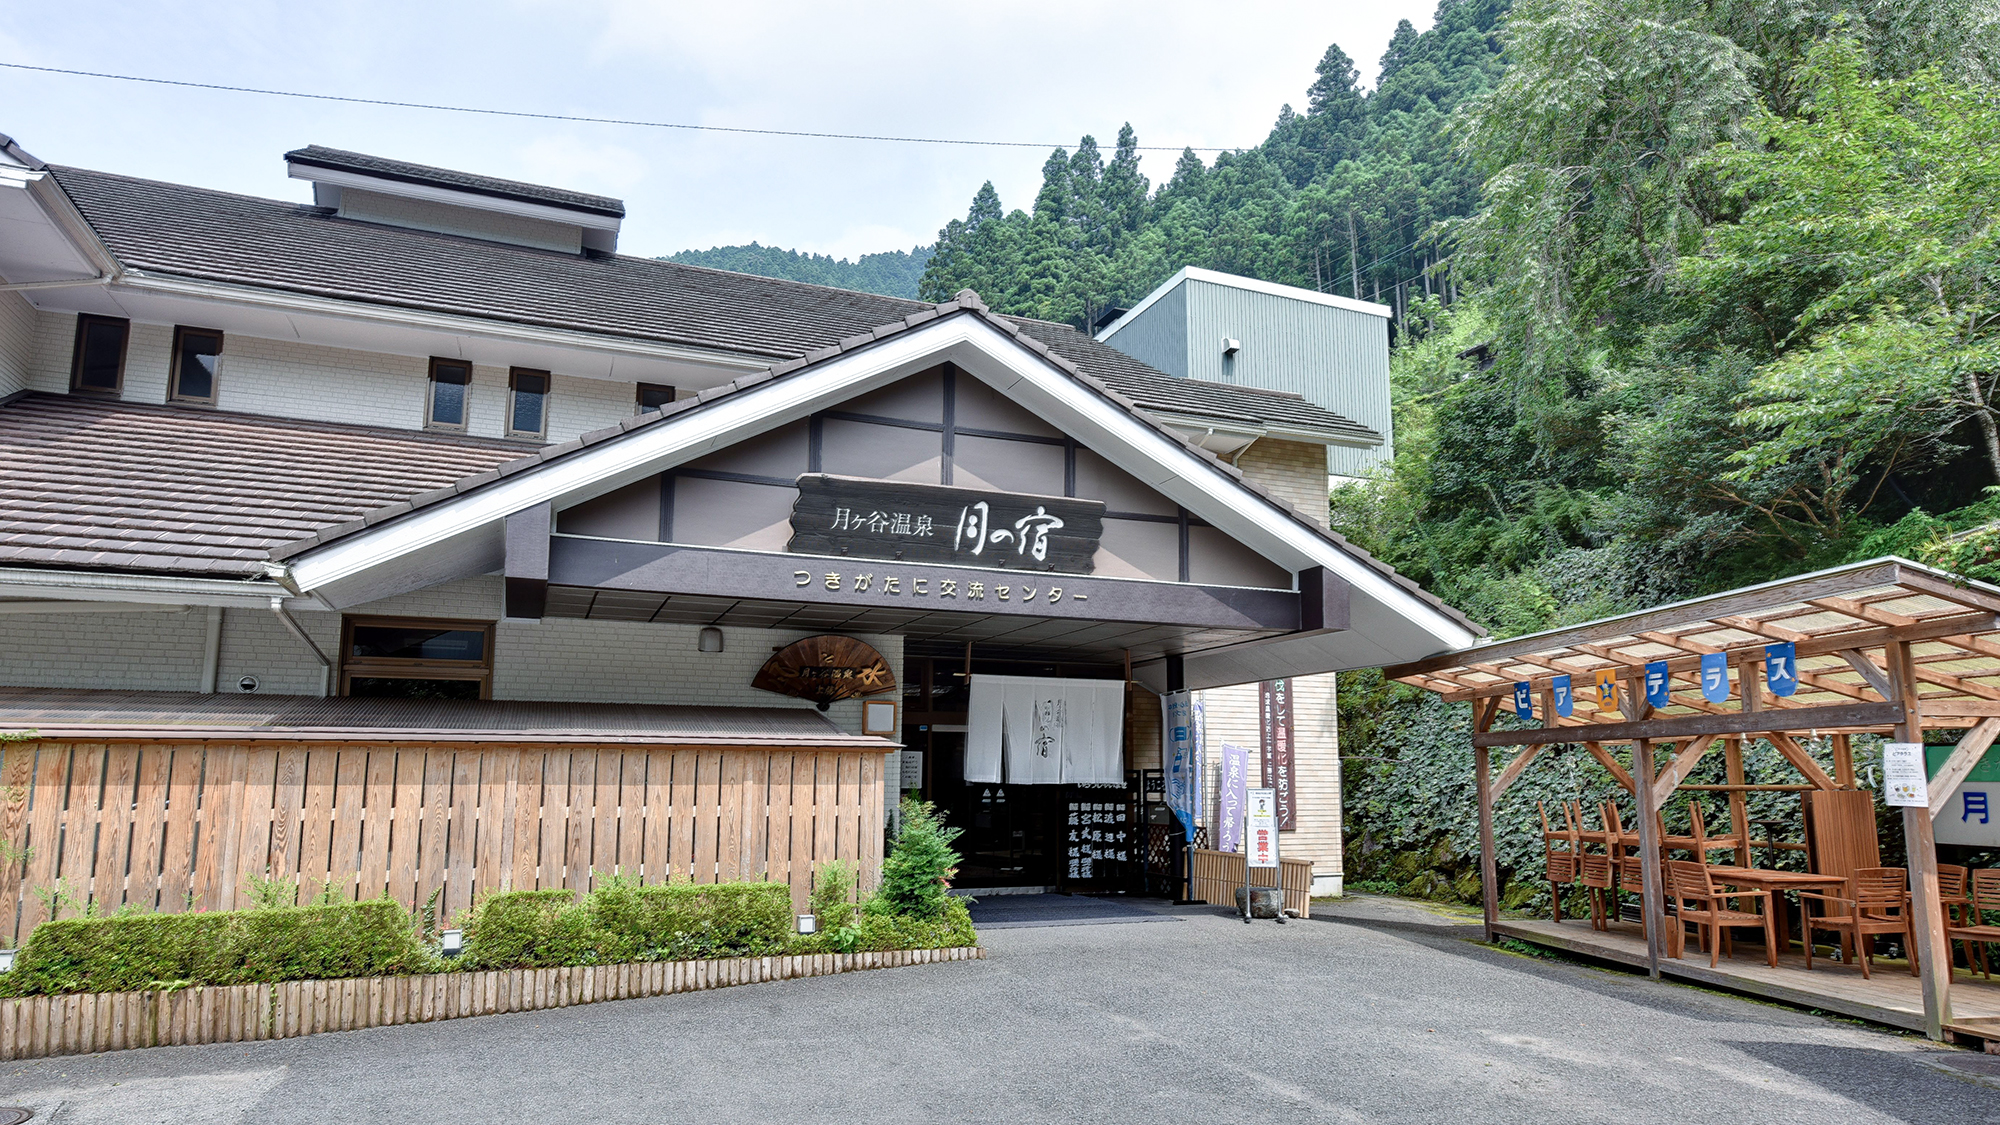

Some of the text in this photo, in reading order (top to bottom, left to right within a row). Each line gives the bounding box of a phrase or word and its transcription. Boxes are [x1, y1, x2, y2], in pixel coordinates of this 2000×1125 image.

[954, 501, 1064, 562] 月の宿
[793, 570, 1088, 603] つきがたに交流センター
[1961, 792, 1989, 824] 月
[1257, 829, 1269, 864] 営業中
